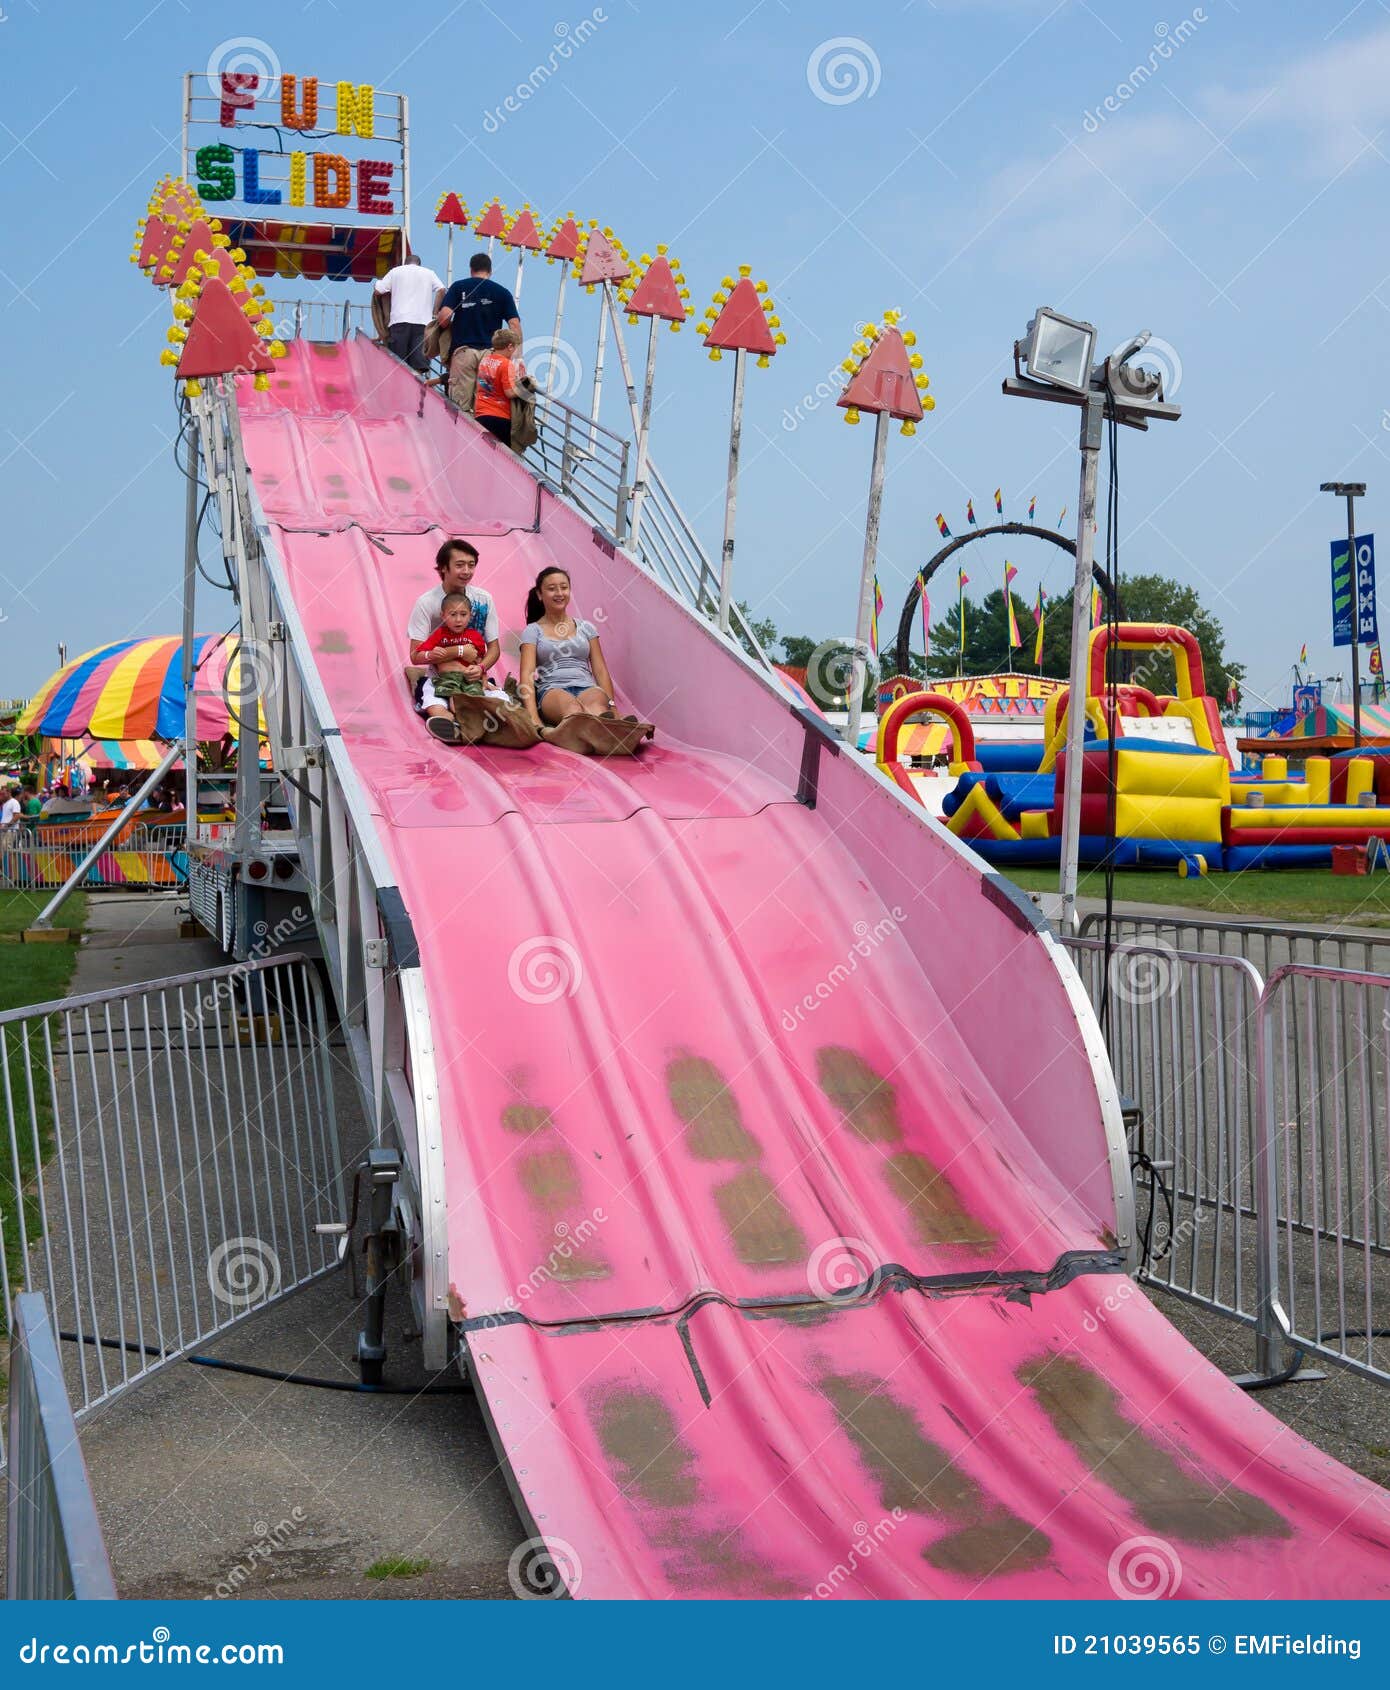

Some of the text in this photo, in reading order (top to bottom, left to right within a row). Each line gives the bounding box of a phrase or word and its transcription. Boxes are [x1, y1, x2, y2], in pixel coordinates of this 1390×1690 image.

[220, 72, 374, 139] FUN
[195, 145, 394, 215] SLIDE
[1358, 544, 1374, 634] EXPO
